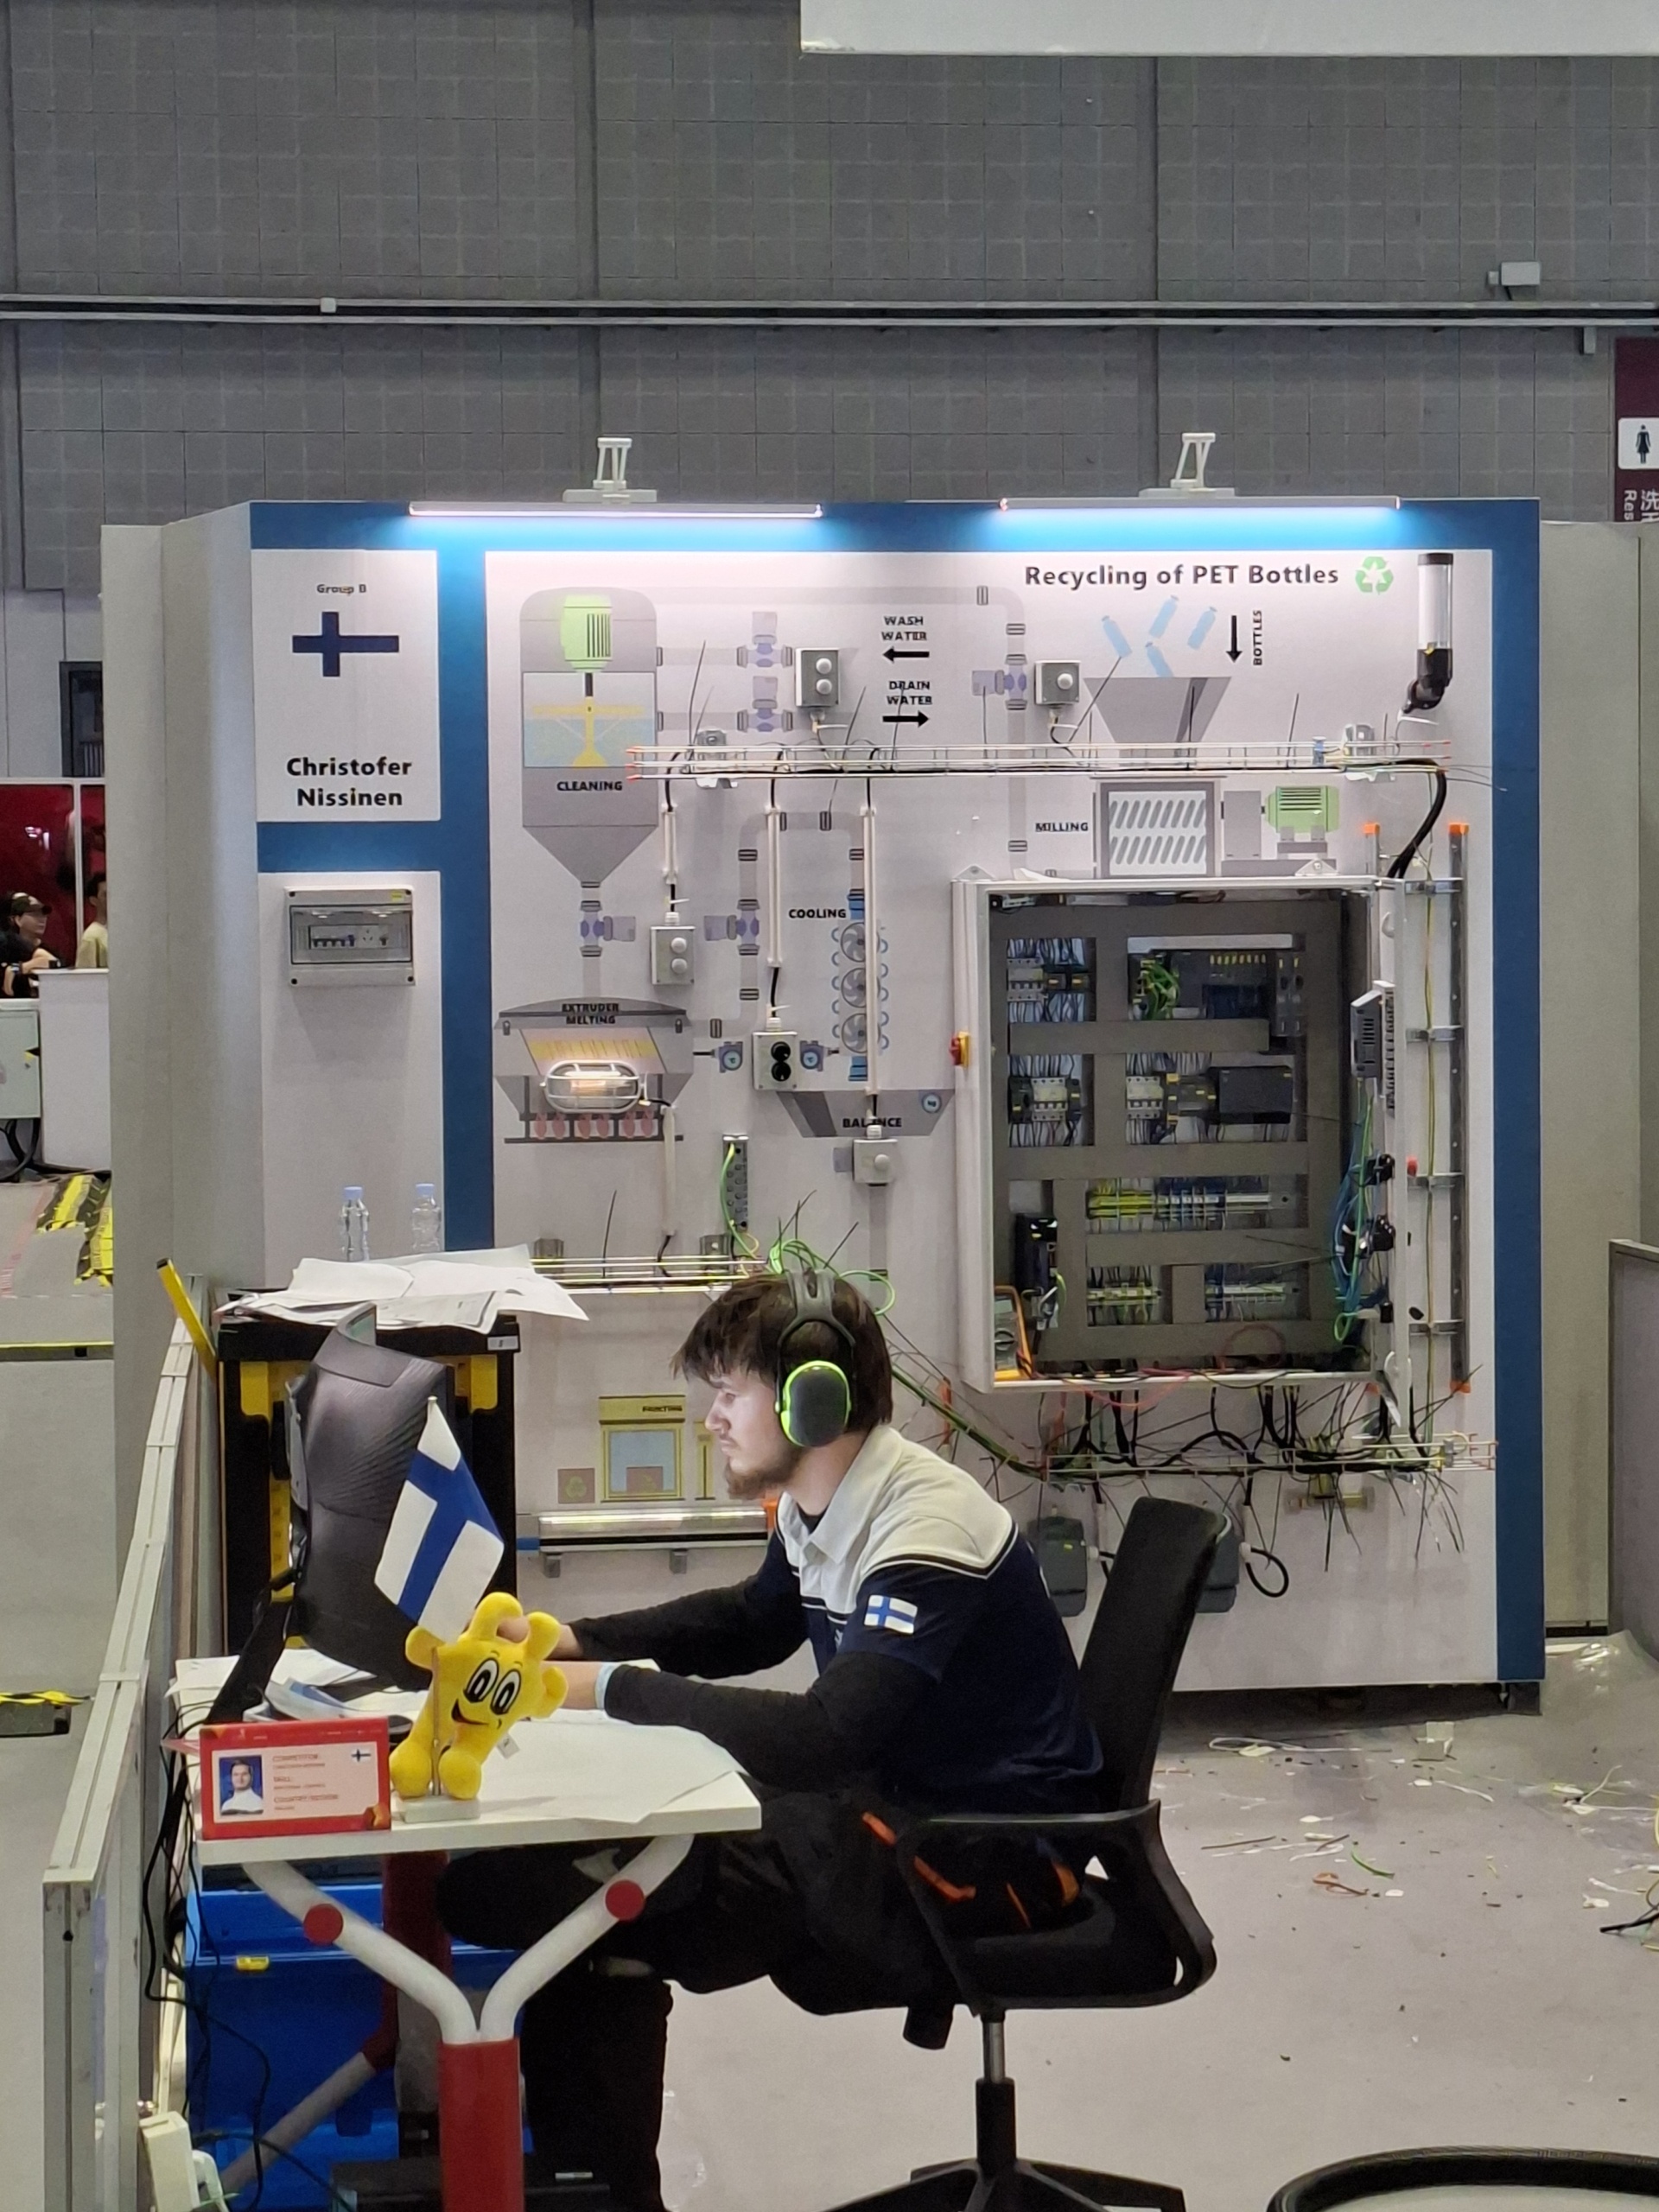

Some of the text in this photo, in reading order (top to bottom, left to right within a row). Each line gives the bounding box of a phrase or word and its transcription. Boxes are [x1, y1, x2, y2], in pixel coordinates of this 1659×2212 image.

[1025, 563, 1339, 591] Recycling of PET Bottles
[316, 583, 354, 596] Group
[884, 615, 924, 626] WASH
[881, 631, 928, 641] WATER
[1253, 610, 1263, 666] BOTTLES
[888, 680, 931, 690] DRAIN
[887, 696, 933, 705] WATER
[286, 756, 413, 776] Christofer
[556, 780, 624, 791] CLEANING
[296, 787, 403, 807] Nissinen
[1035, 822, 1090, 832] MILLING
[788, 908, 847, 918] COOLING
[562, 1003, 620, 1013] EXTRUDER
[566, 1014, 616, 1025] MELTING
